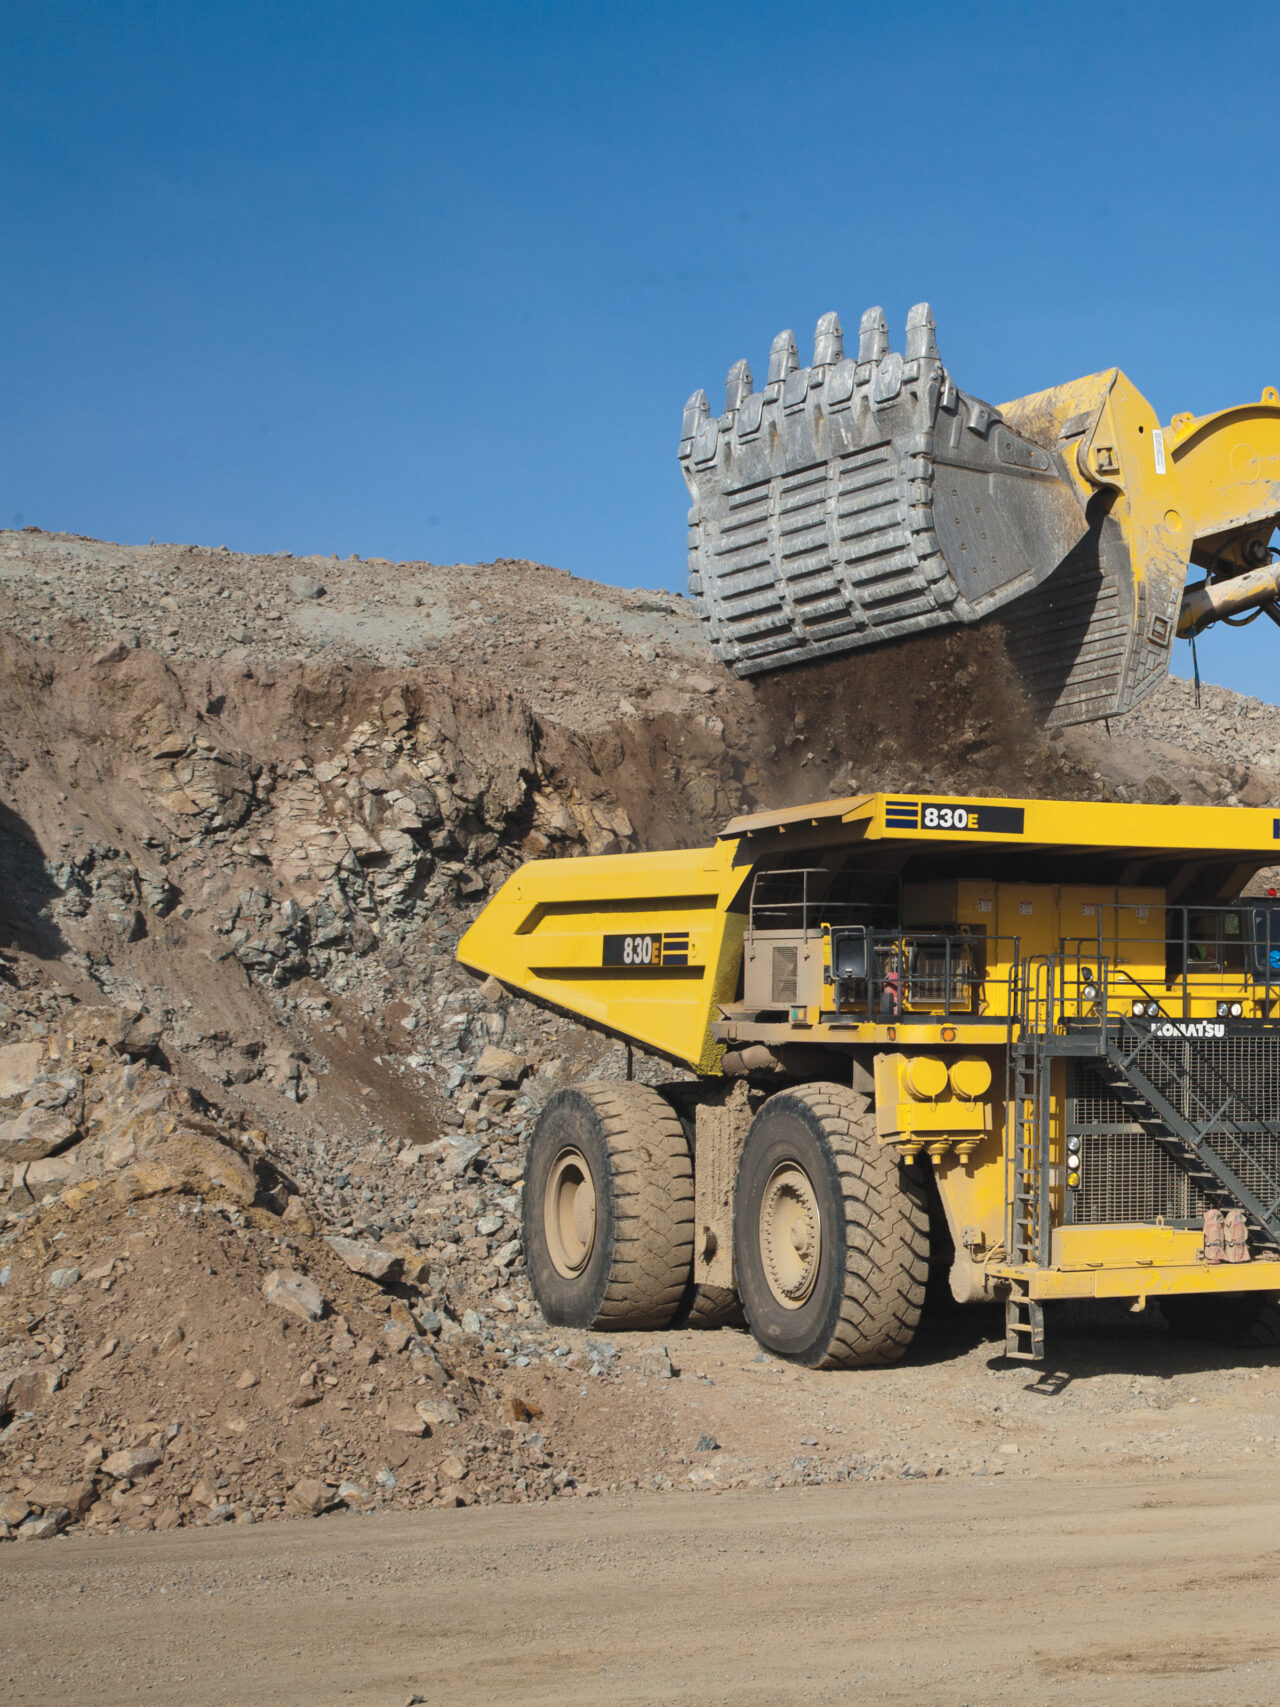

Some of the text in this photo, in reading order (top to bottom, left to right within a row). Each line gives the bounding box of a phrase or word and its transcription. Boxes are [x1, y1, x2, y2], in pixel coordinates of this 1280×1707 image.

[924, 807, 979, 829] 830E
[623, 936, 660, 964] 830E
[1151, 1020, 1225, 1038] KOMATSU
